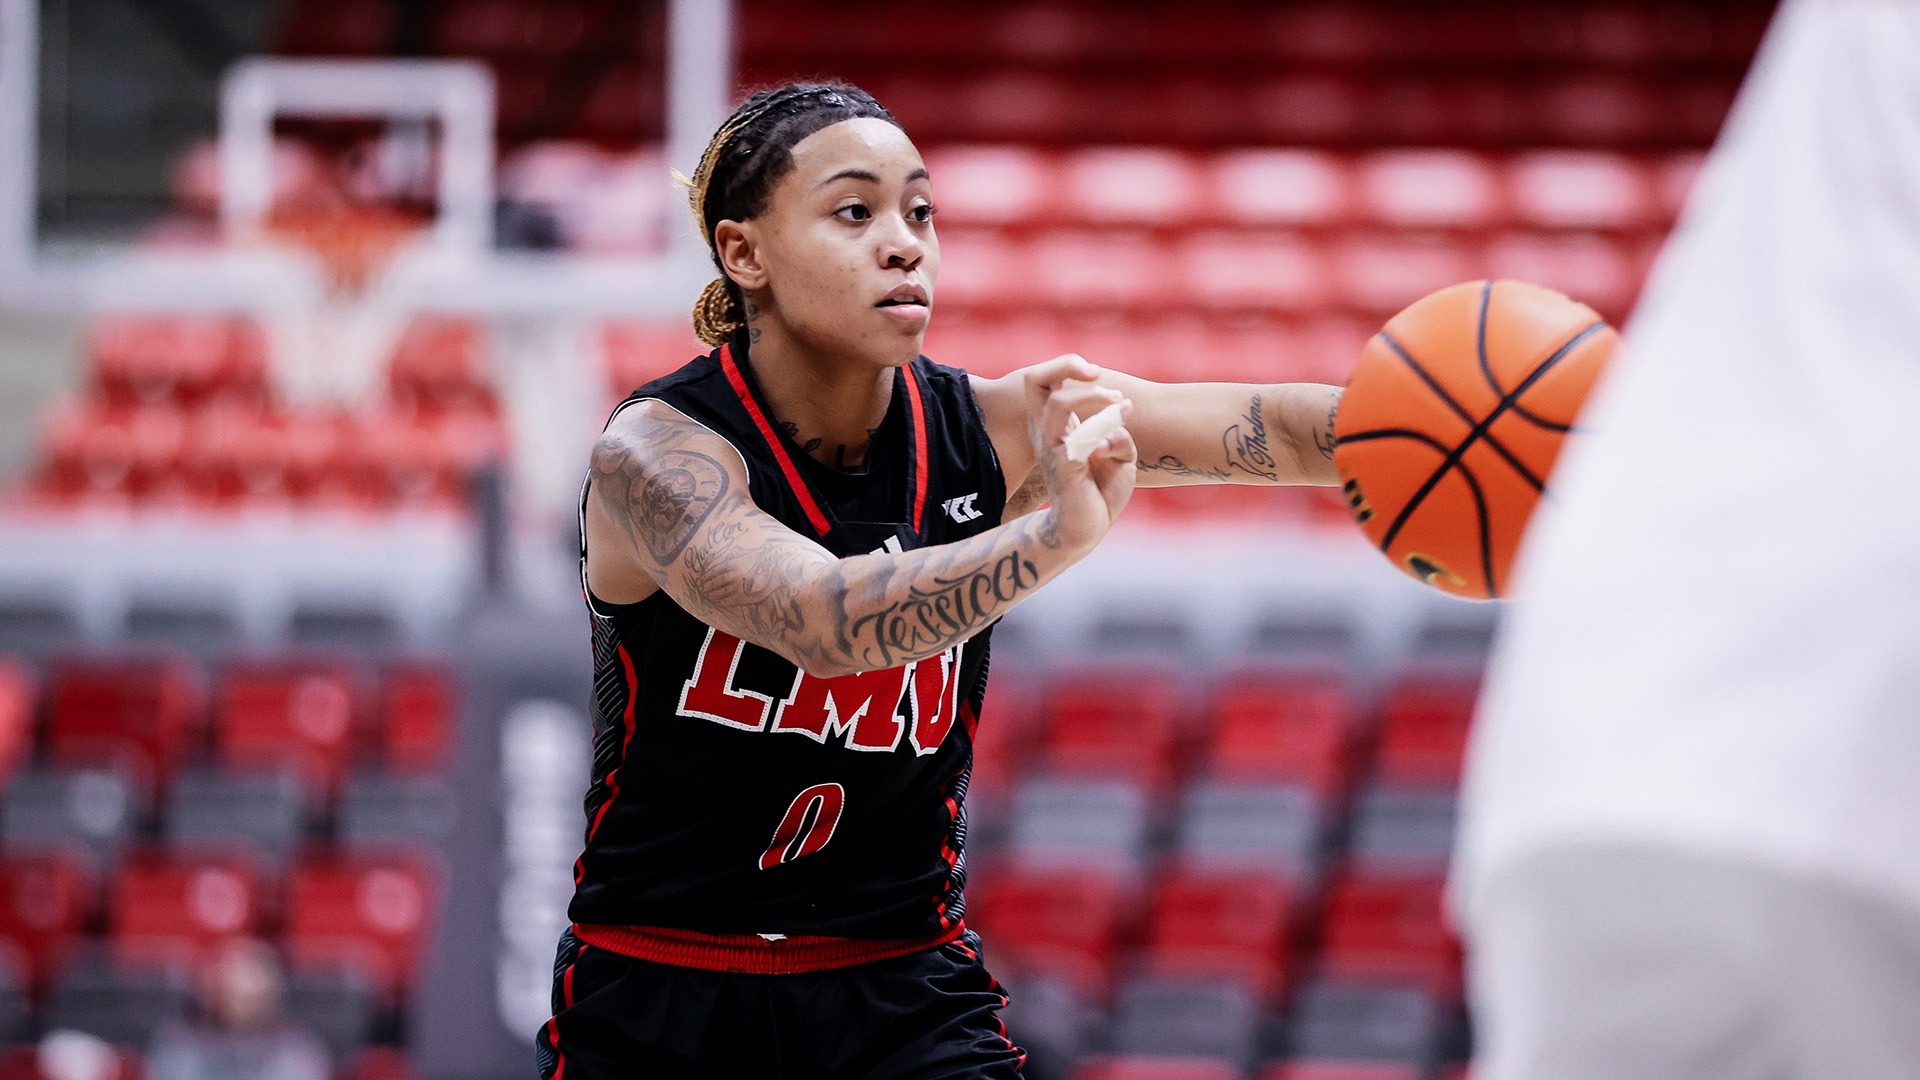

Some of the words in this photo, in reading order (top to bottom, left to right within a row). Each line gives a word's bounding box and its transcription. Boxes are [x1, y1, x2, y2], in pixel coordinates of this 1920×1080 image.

[852, 550, 1039, 668] Jessica
[676, 624, 969, 757] LMU
[759, 783, 846, 870] 0
